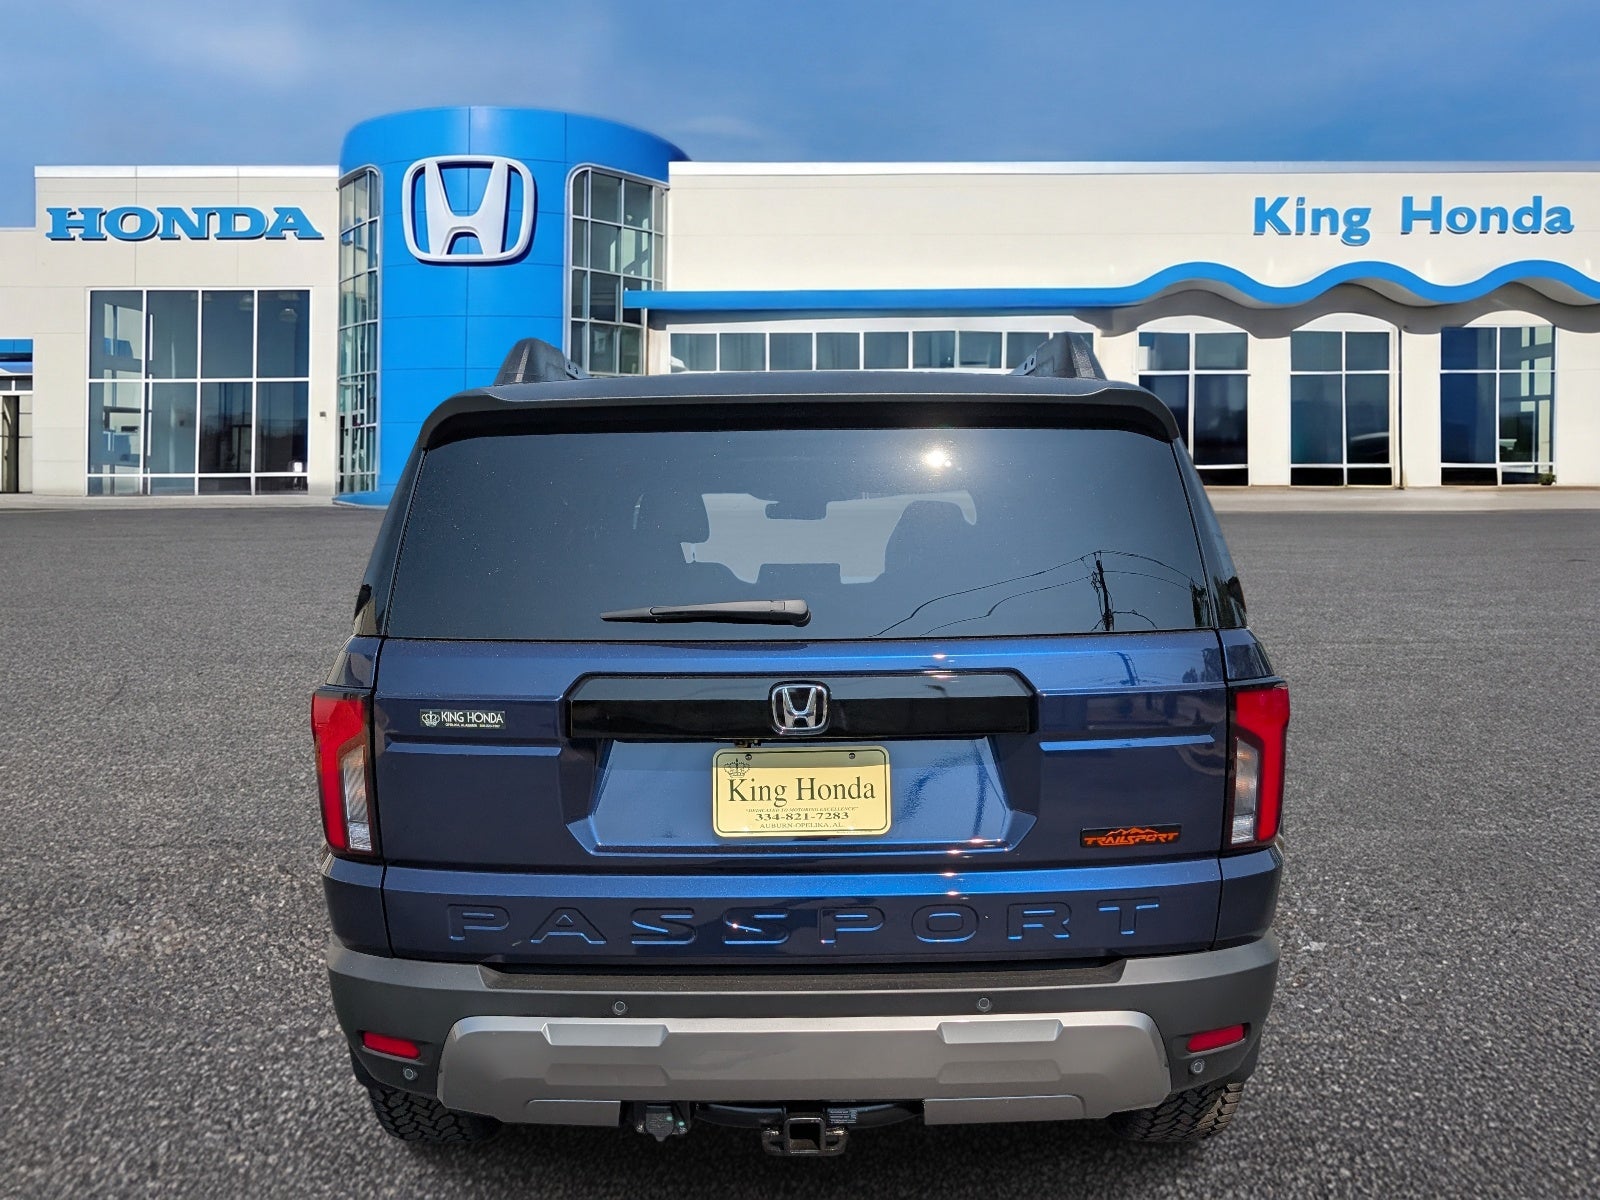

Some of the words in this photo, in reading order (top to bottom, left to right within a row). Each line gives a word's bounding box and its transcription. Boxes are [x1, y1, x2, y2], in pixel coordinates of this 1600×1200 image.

[45, 206, 324, 241] HONDA
[1253, 196, 1372, 247] King
[1401, 195, 1575, 235] Honda
[441, 711, 464, 723] KING
[467, 712, 504, 724] HONDA
[728, 777, 788, 808] King
[795, 775, 876, 801] Honda
[755, 812, 849, 821] 334-821-7283
[1083, 832, 1179, 846] TRAILSPORT
[448, 897, 1160, 945] PASSPORT
